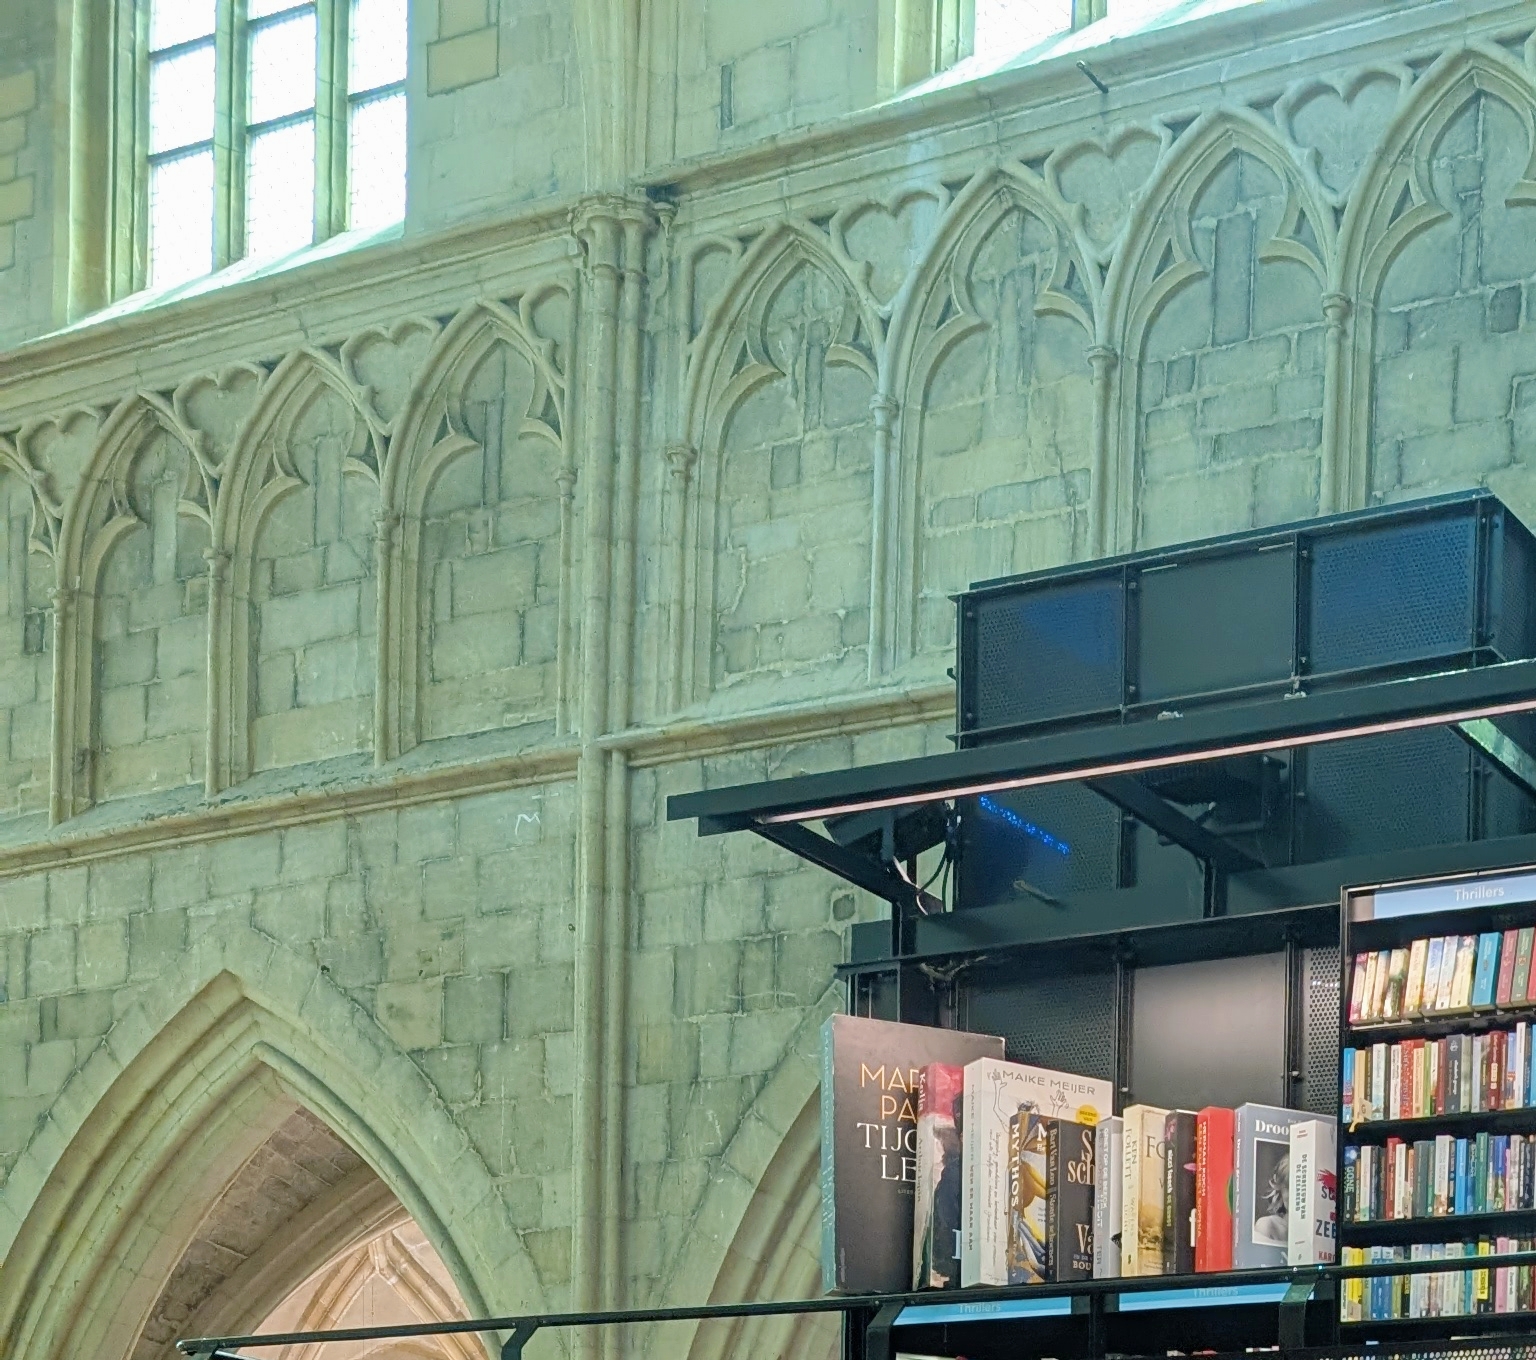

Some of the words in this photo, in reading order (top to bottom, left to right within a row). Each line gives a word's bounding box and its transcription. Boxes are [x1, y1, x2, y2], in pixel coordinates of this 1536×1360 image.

[1454, 884, 1504, 902] Thrillers
[1002, 1070, 1045, 1086] MAIKE
[1050, 1080, 1096, 1096] MEIJER
[1011, 1123, 1019, 1207] MYTHOS
[1124, 1128, 1132, 1180] FOLLETT
